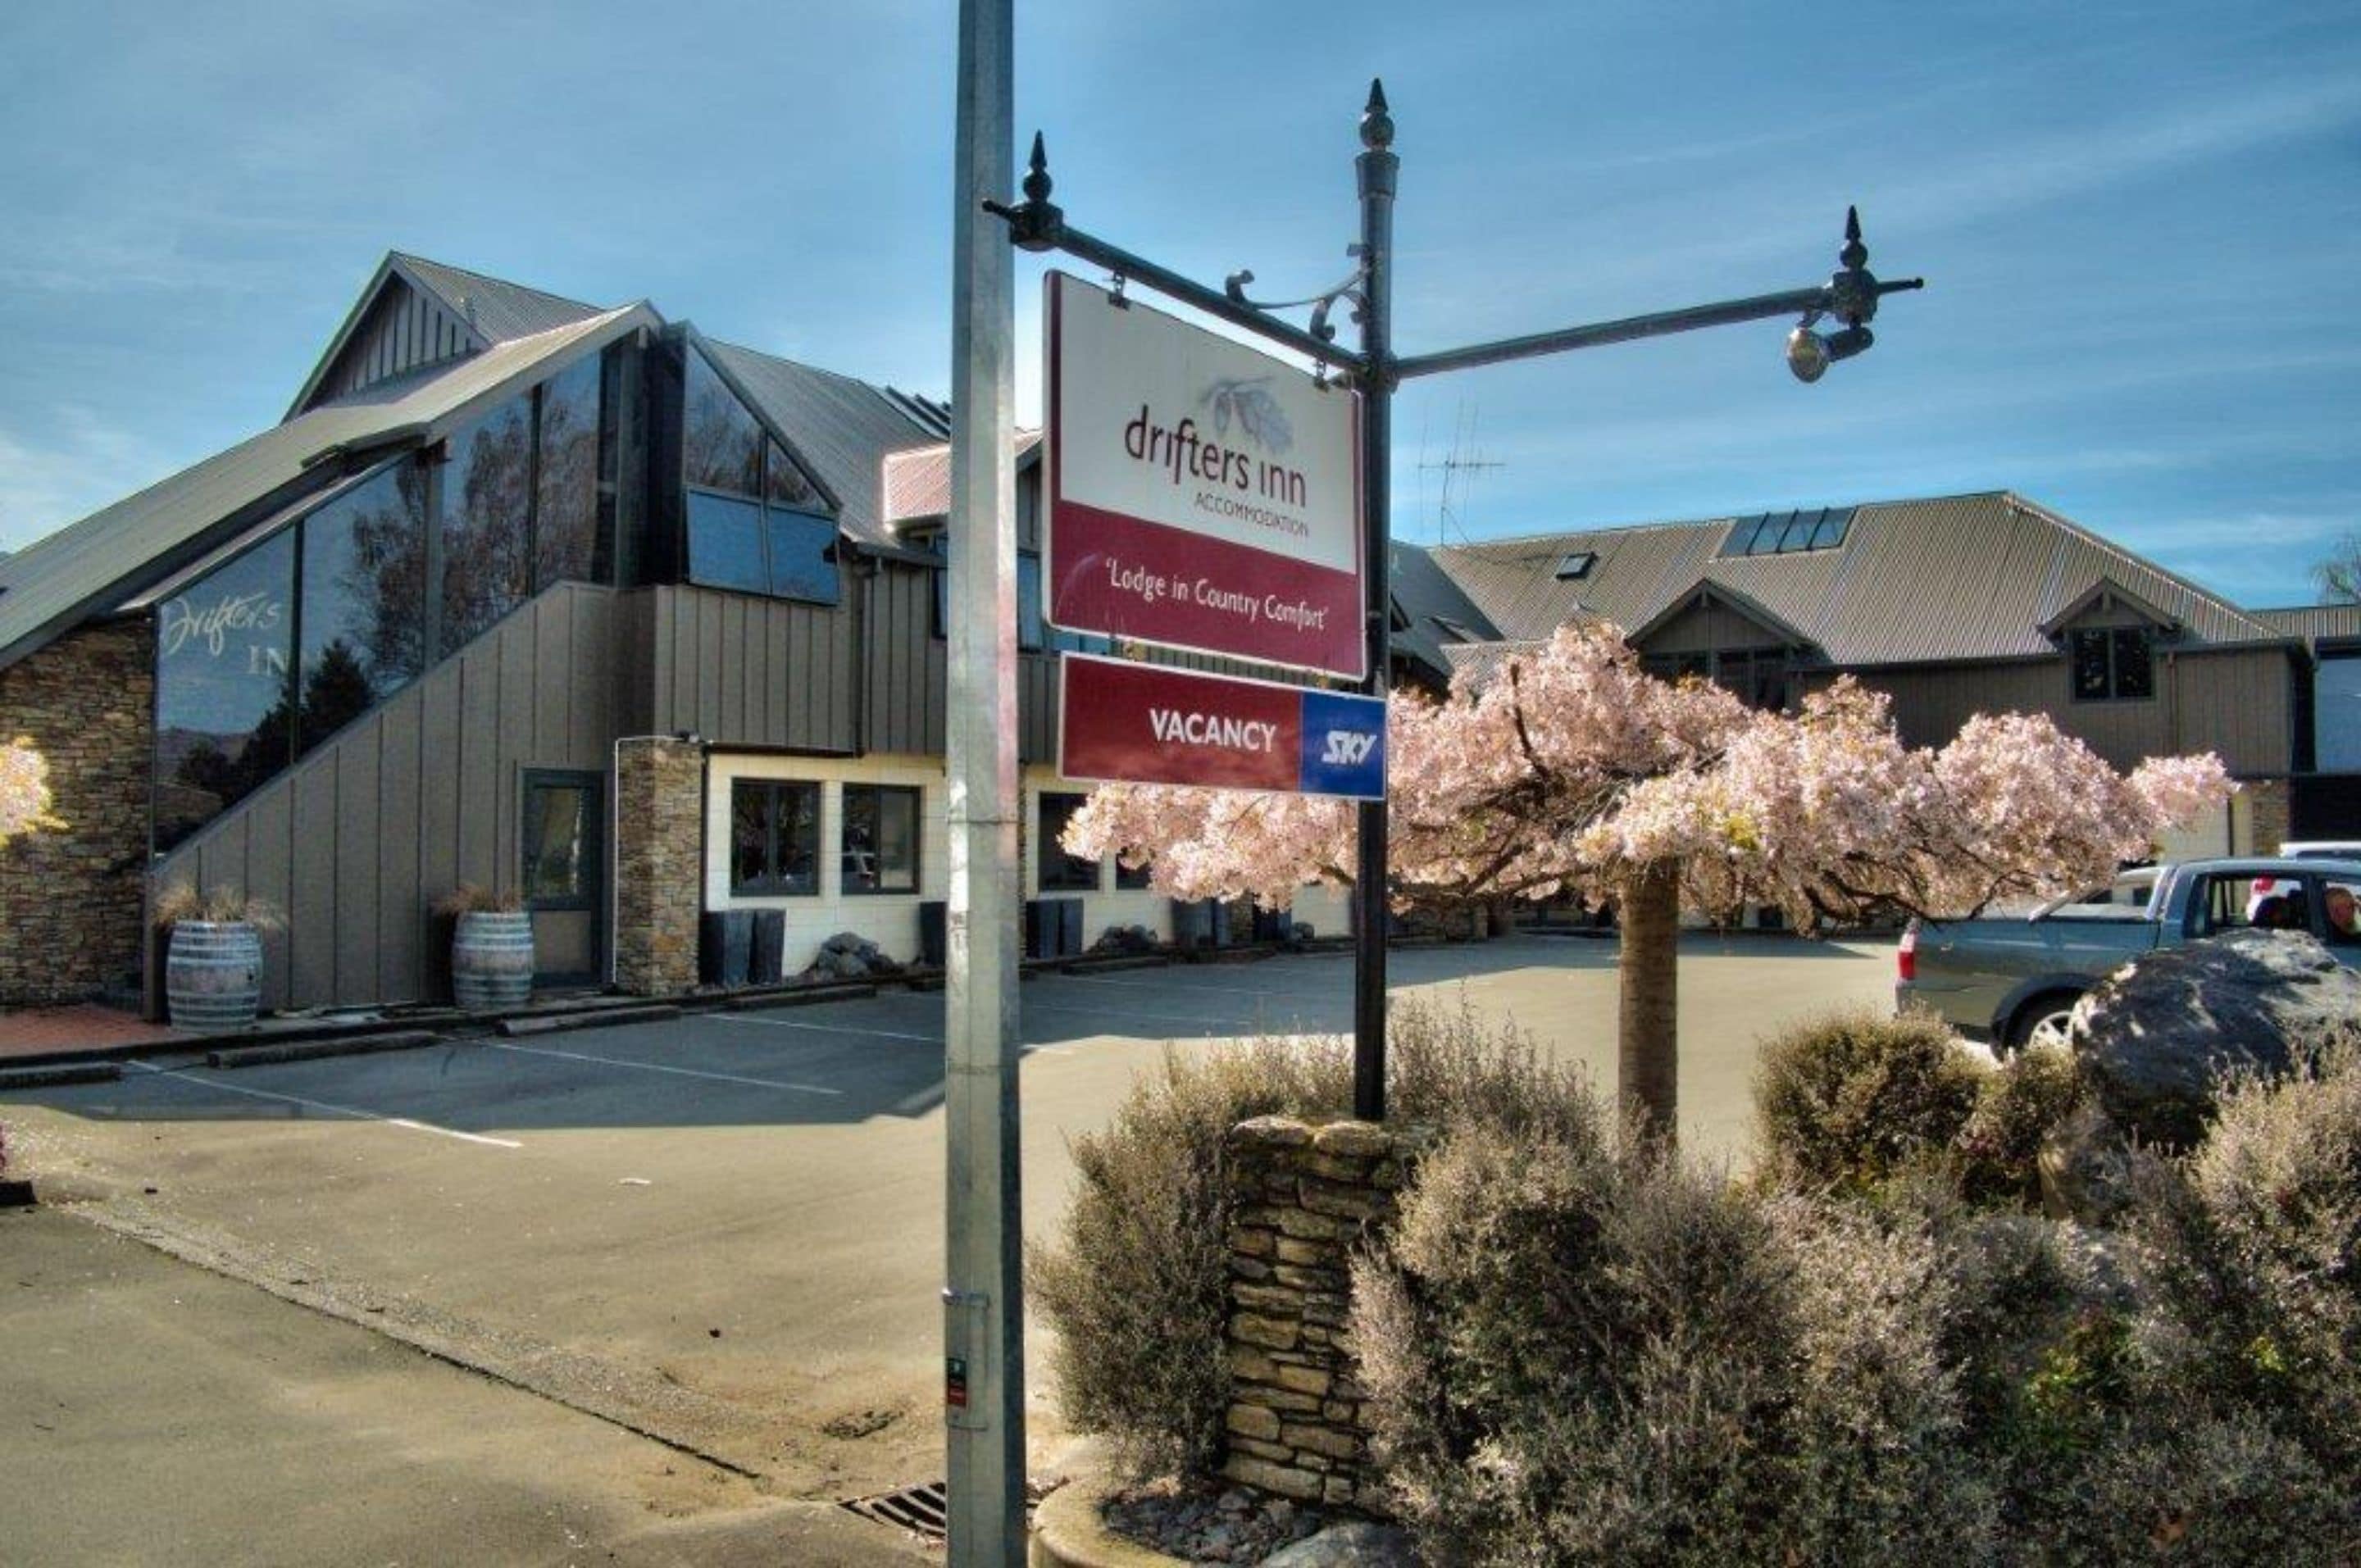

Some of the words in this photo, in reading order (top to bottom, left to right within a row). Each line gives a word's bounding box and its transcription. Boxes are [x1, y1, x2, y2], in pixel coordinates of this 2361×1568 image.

[1125, 405, 1250, 491] drifters
[1260, 461, 1307, 507] inn
[1194, 492, 1309, 538] ACCOMMODATION
[1173, 575, 1190, 602] in
[1195, 578, 1259, 621] Country
[1150, 708, 1277, 752] VACANCY
[1322, 730, 1377, 764] SKY
